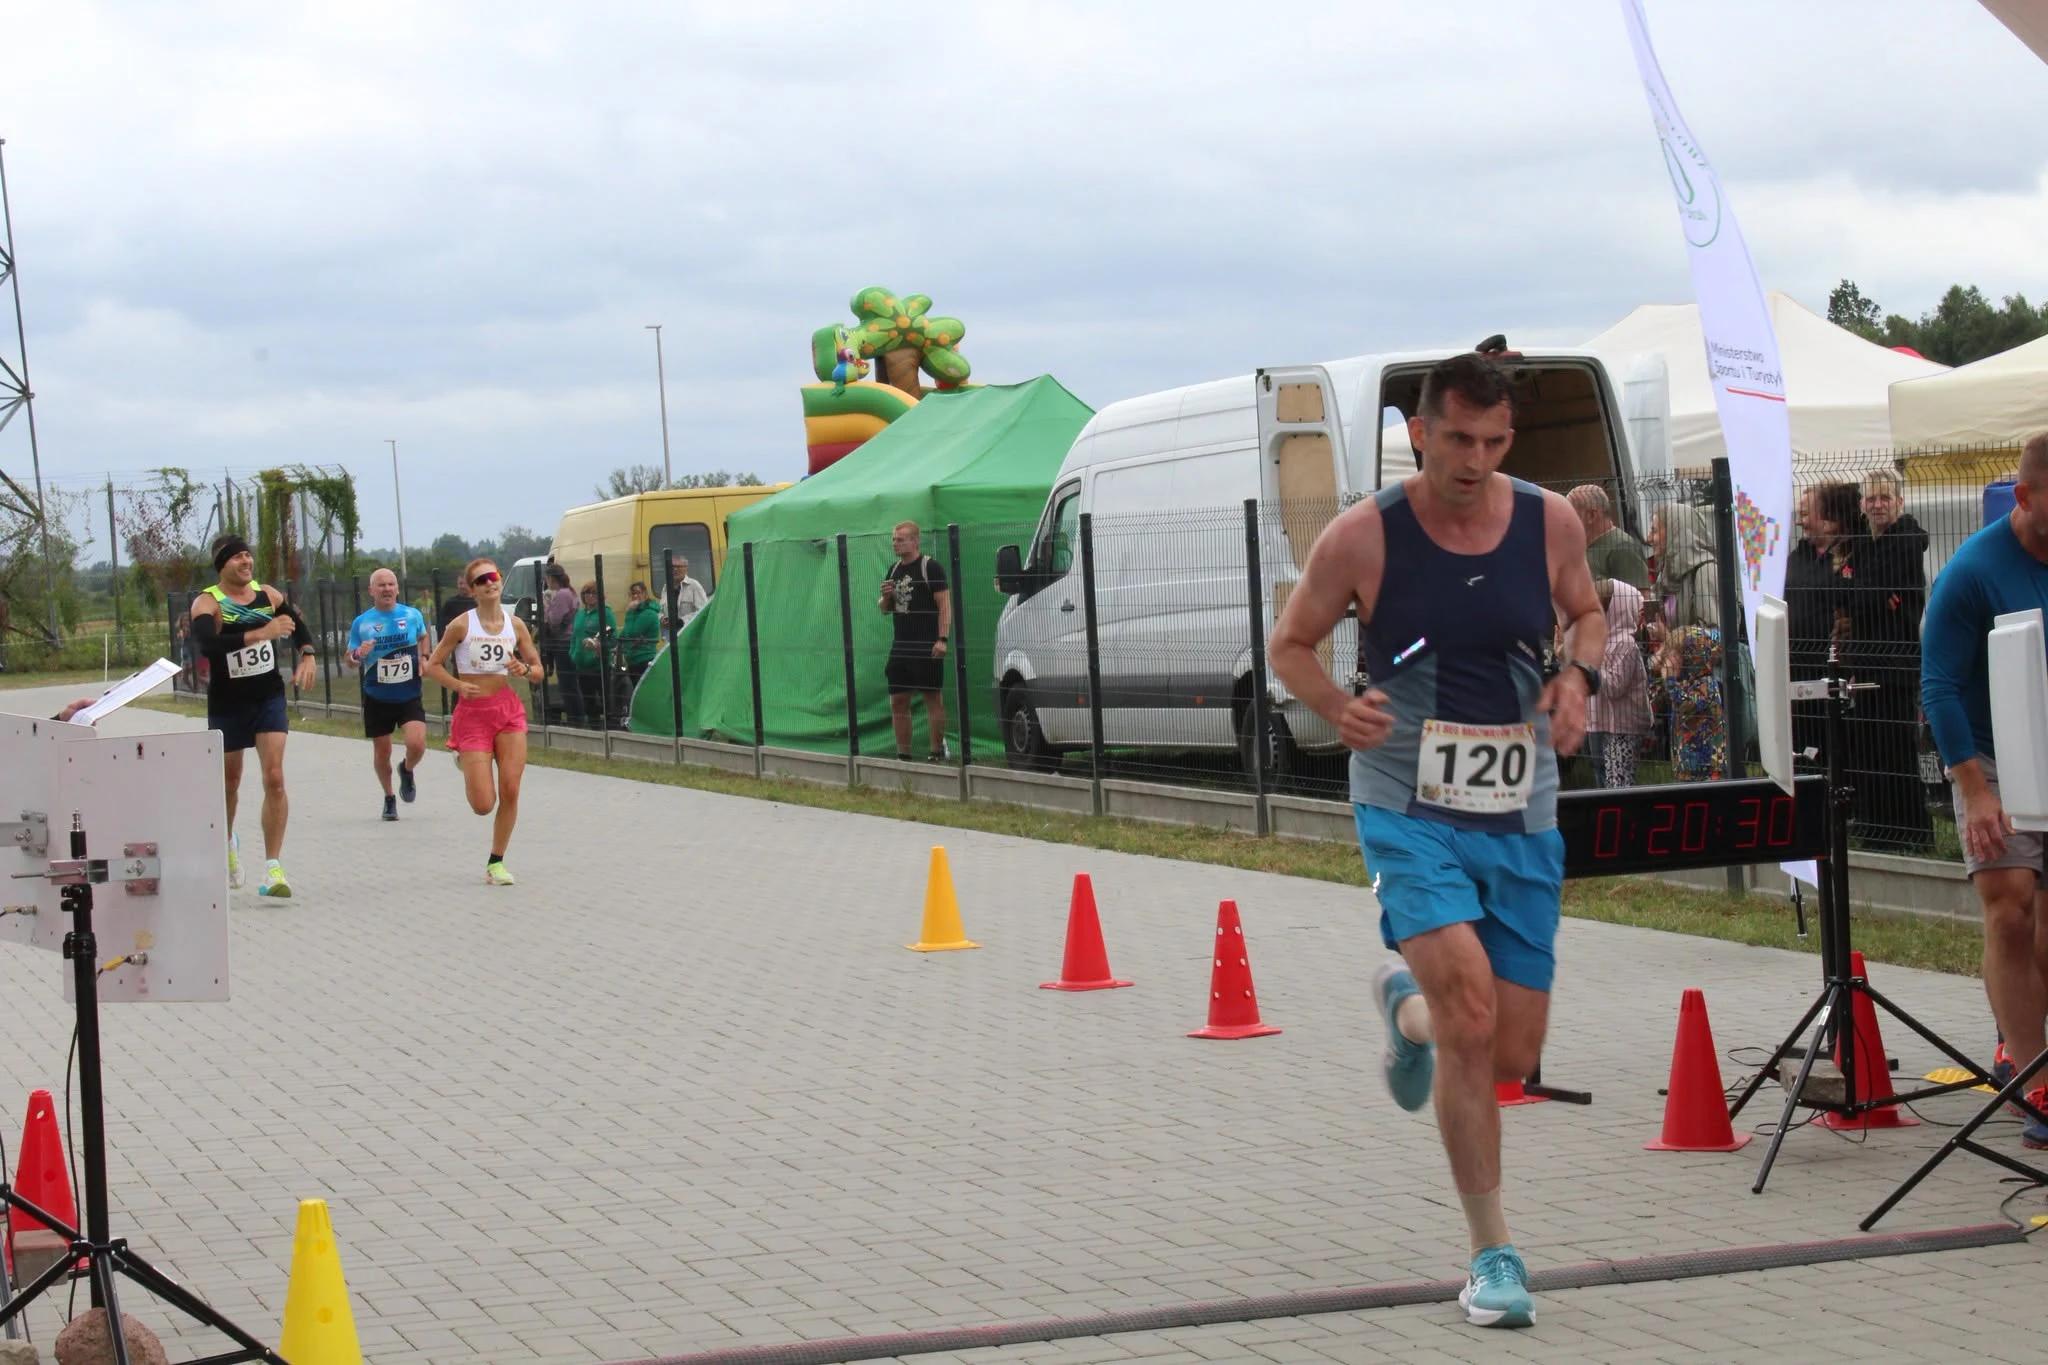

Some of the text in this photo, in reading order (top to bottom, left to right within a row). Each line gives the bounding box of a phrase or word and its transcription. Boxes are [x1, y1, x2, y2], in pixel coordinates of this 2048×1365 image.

[232, 644, 271, 668] 136
[480, 643, 504, 662] 39
[381, 661, 410, 677] 179
[1435, 742, 1527, 787] 120
